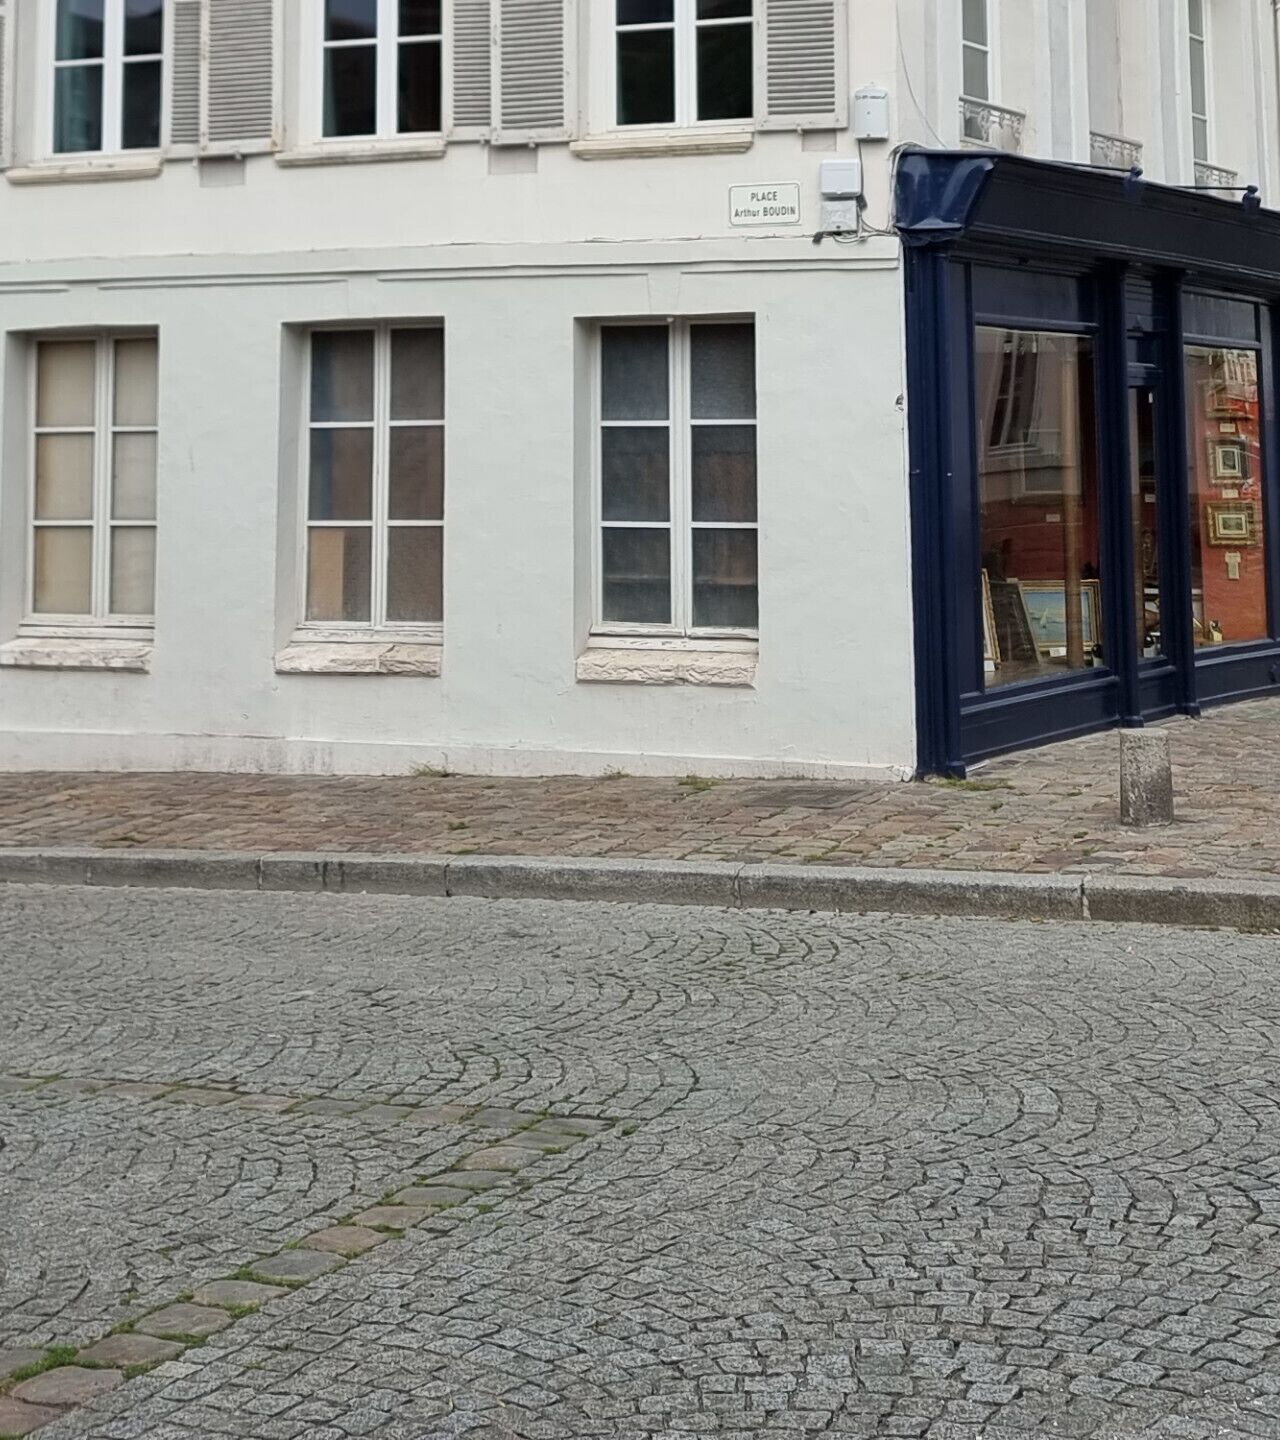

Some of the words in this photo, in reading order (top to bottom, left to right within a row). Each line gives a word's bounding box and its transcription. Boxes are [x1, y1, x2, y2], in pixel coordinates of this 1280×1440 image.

[750, 191, 778, 202] PLACE
[734, 208, 760, 218] Arthur
[763, 206, 796, 217] BOUDIN
